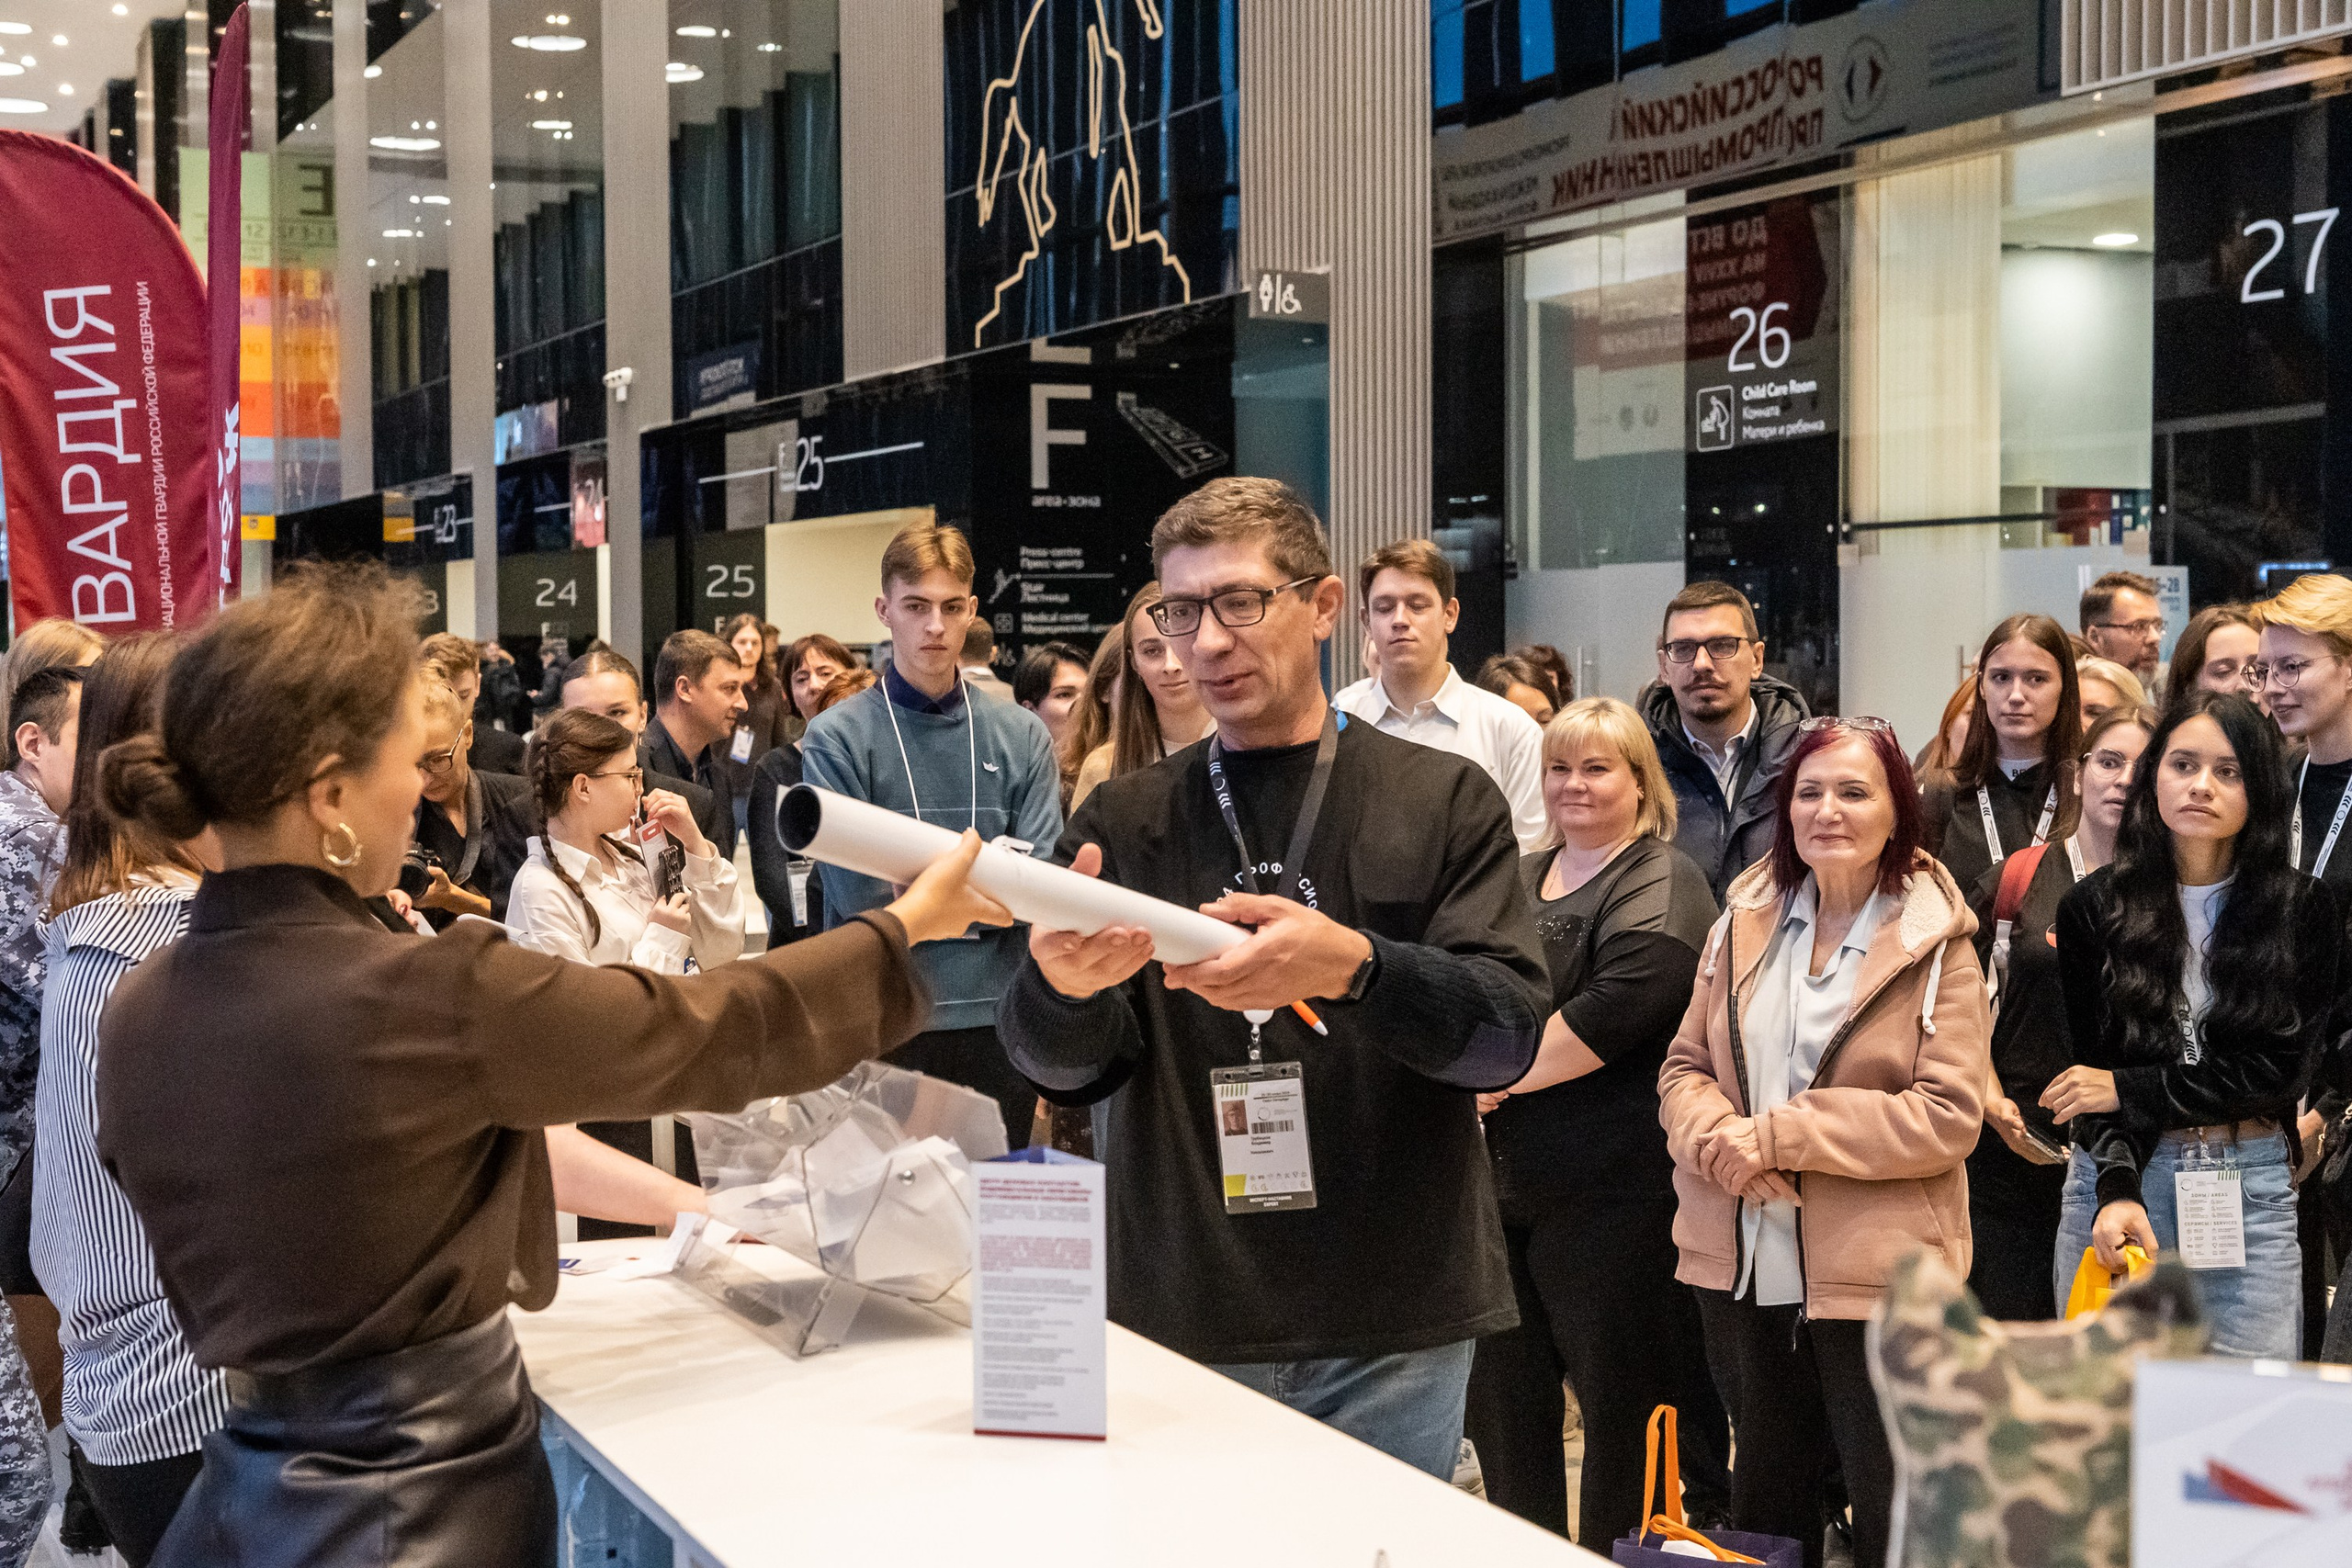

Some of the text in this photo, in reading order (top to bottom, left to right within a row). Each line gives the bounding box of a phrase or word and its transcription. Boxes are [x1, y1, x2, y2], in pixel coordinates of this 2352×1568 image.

[2241, 207, 2340, 304] 27
[136, 280, 155, 364] ФЕДЕРАЦИИ
[1727, 301, 1792, 372] 26
[141, 365, 164, 457] РОССИЙСКОЙ
[1742, 379, 1817, 400] Child Care Room
[796, 434, 824, 491] 25
[1030, 383, 1092, 490] F
[151, 457, 170, 521] ГВАРДИИ
[535, 578, 578, 607] 24
[706, 564, 755, 598] 25
